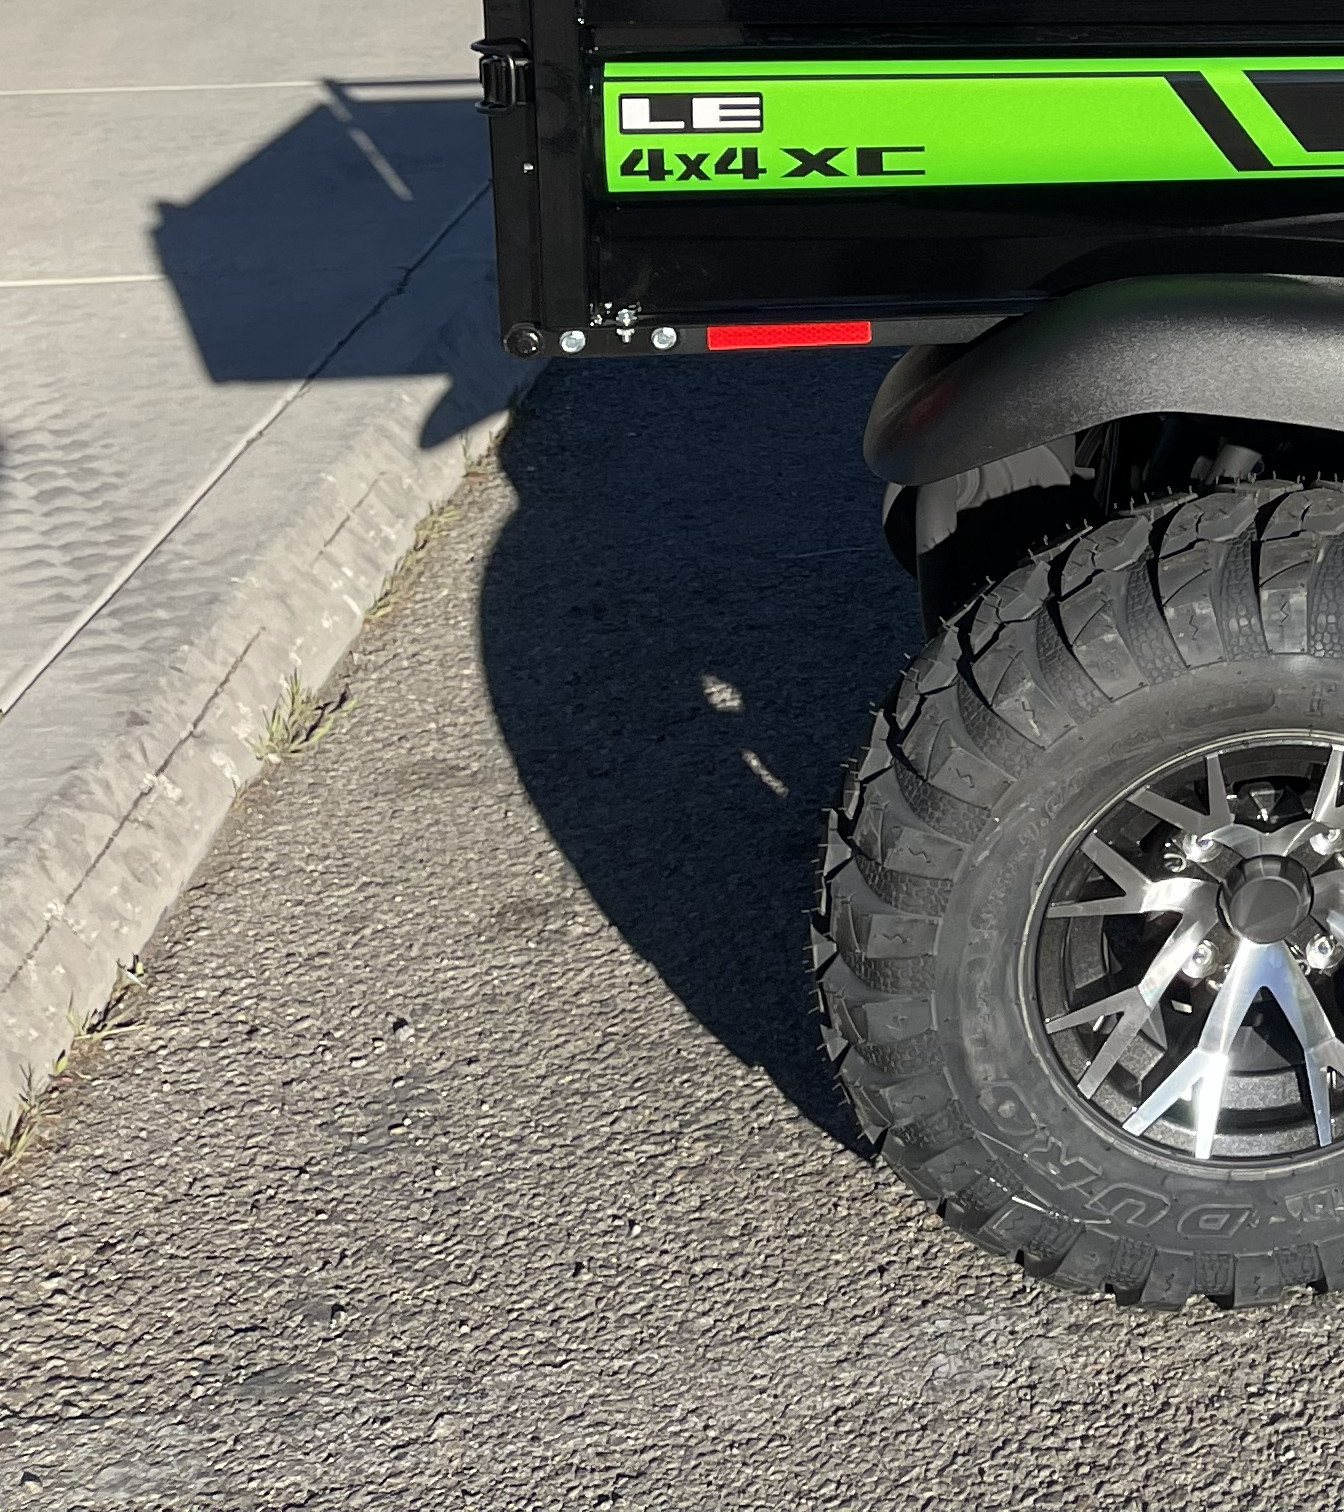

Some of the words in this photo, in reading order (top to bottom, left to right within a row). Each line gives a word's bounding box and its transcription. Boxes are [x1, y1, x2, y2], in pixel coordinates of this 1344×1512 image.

[620, 96, 762, 131] LE
[619, 146, 768, 182] 4x4
[778, 145, 926, 179] XC
[980, 1078, 1255, 1240] DURO
